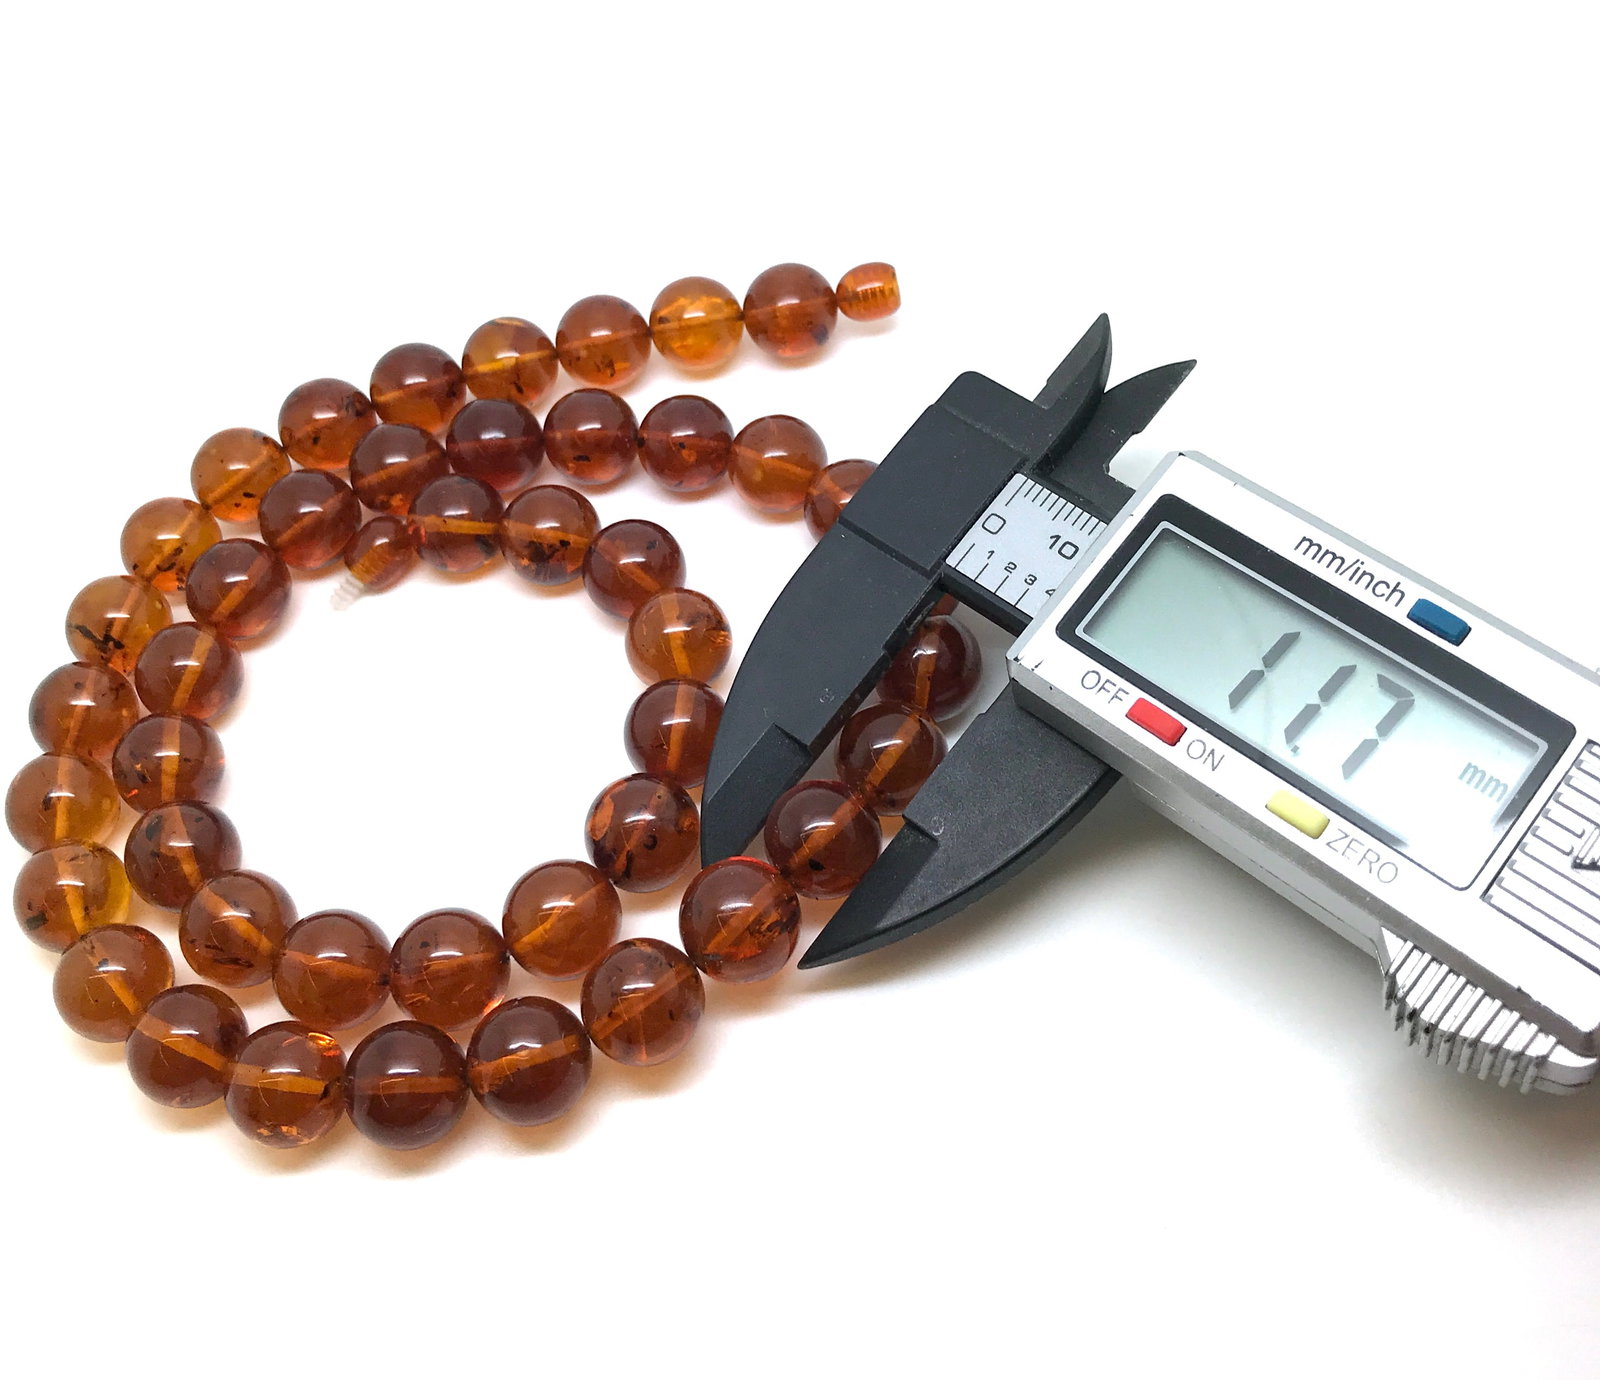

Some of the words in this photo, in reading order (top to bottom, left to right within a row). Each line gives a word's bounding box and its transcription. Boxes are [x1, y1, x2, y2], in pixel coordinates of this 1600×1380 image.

[981, 513, 1007, 535] 0
[1048, 534, 1080, 560] 10
[986, 549, 996, 560] 1
[1004, 562, 1018, 574] 2
[1024, 573, 1038, 586] 3
[1294, 533, 1407, 608] mm/inch
[1080, 669, 1130, 707] OFF
[1228, 631, 1416, 781] 11.7
[1186, 738, 1226, 772] ON
[1458, 761, 1509, 803] mm
[1325, 827, 1399, 885] ZERO
